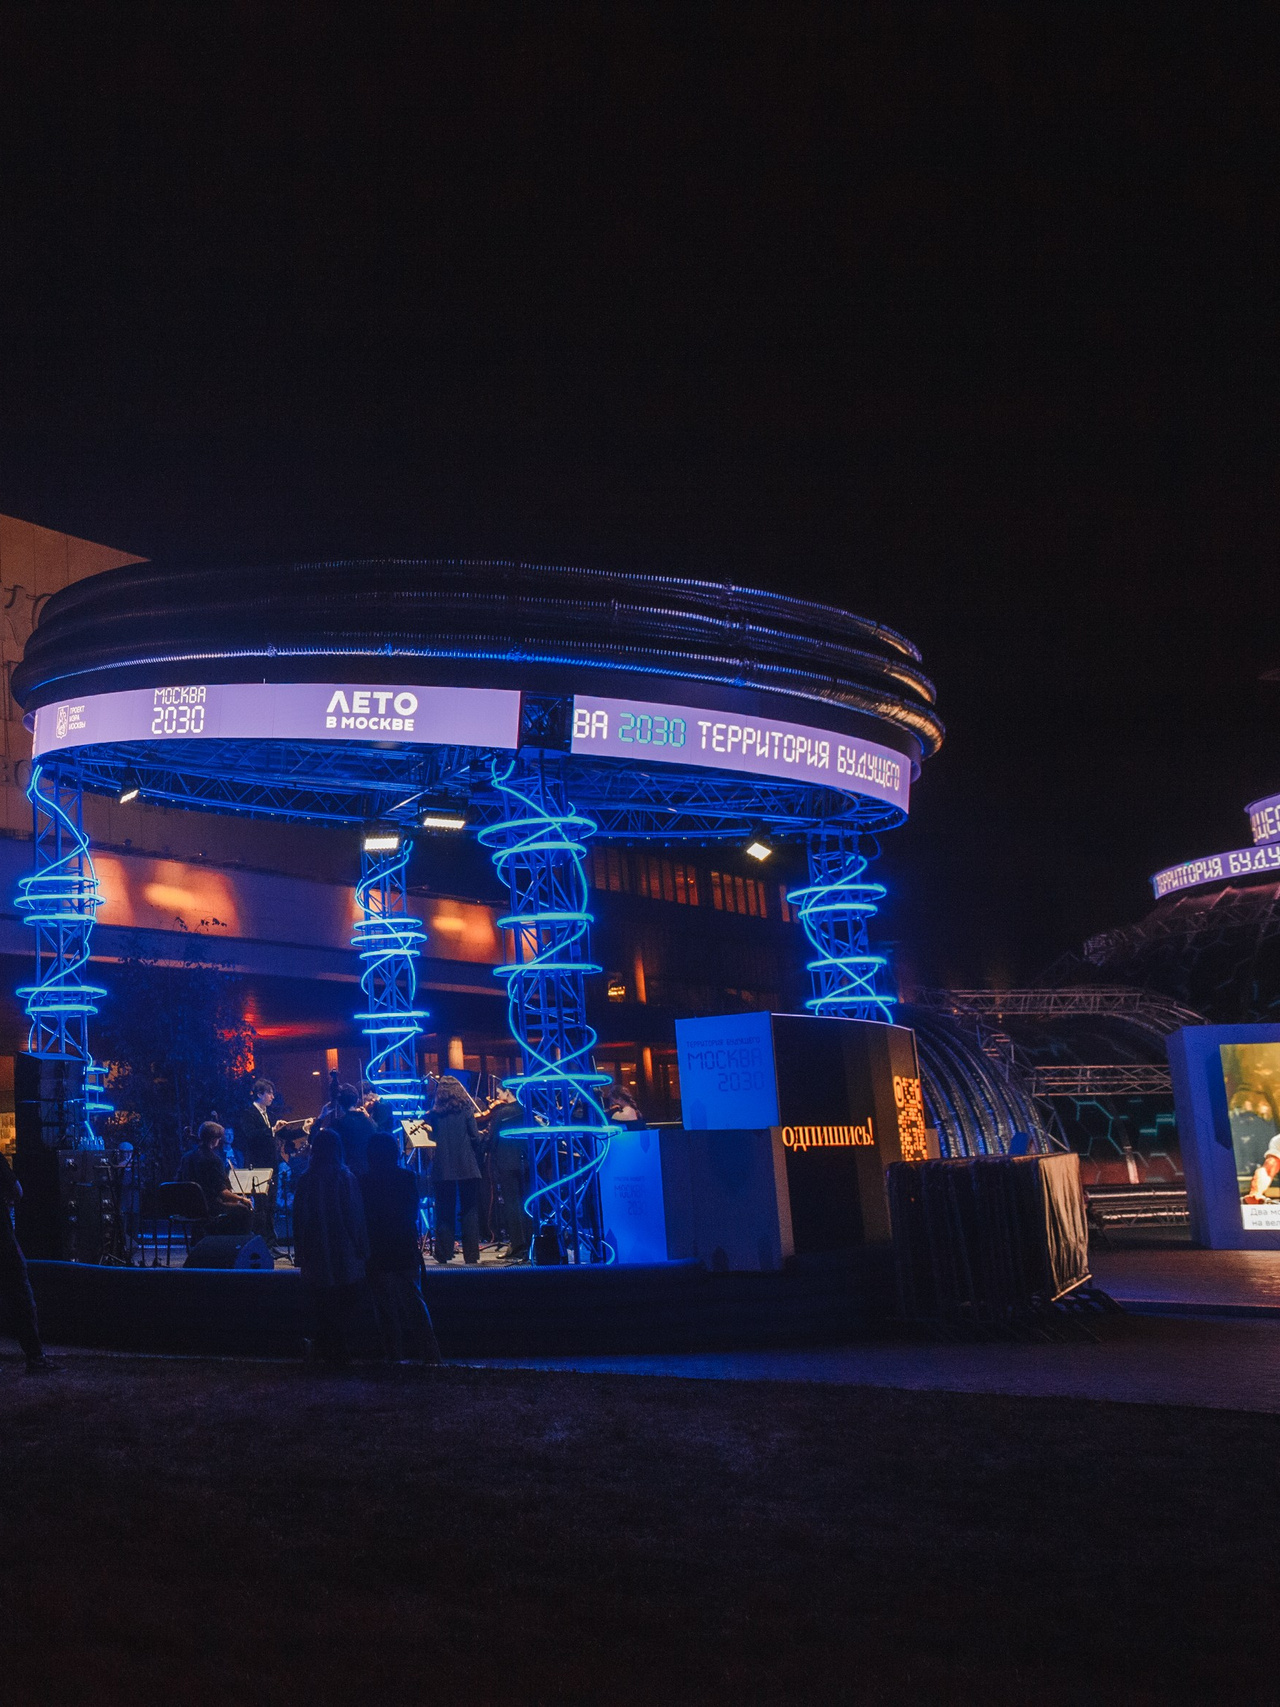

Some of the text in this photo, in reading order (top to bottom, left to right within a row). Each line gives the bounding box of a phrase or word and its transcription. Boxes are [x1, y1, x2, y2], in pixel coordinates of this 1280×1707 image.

[154, 686, 207, 705] МОСКВА
[326, 690, 418, 716] ЛЕТО
[151, 705, 205, 735] 2030
[326, 716, 415, 731] В МОСКВЕ
[619, 712, 686, 747] 2030
[698, 720, 830, 769] ТЕРРИТОРИЯ
[837, 744, 900, 791] БУДУЩЕГО
[687, 1047, 762, 1071] МОСКВА
[718, 1070, 765, 1092] 2030
[782, 1117, 875, 1152] одпишись!
